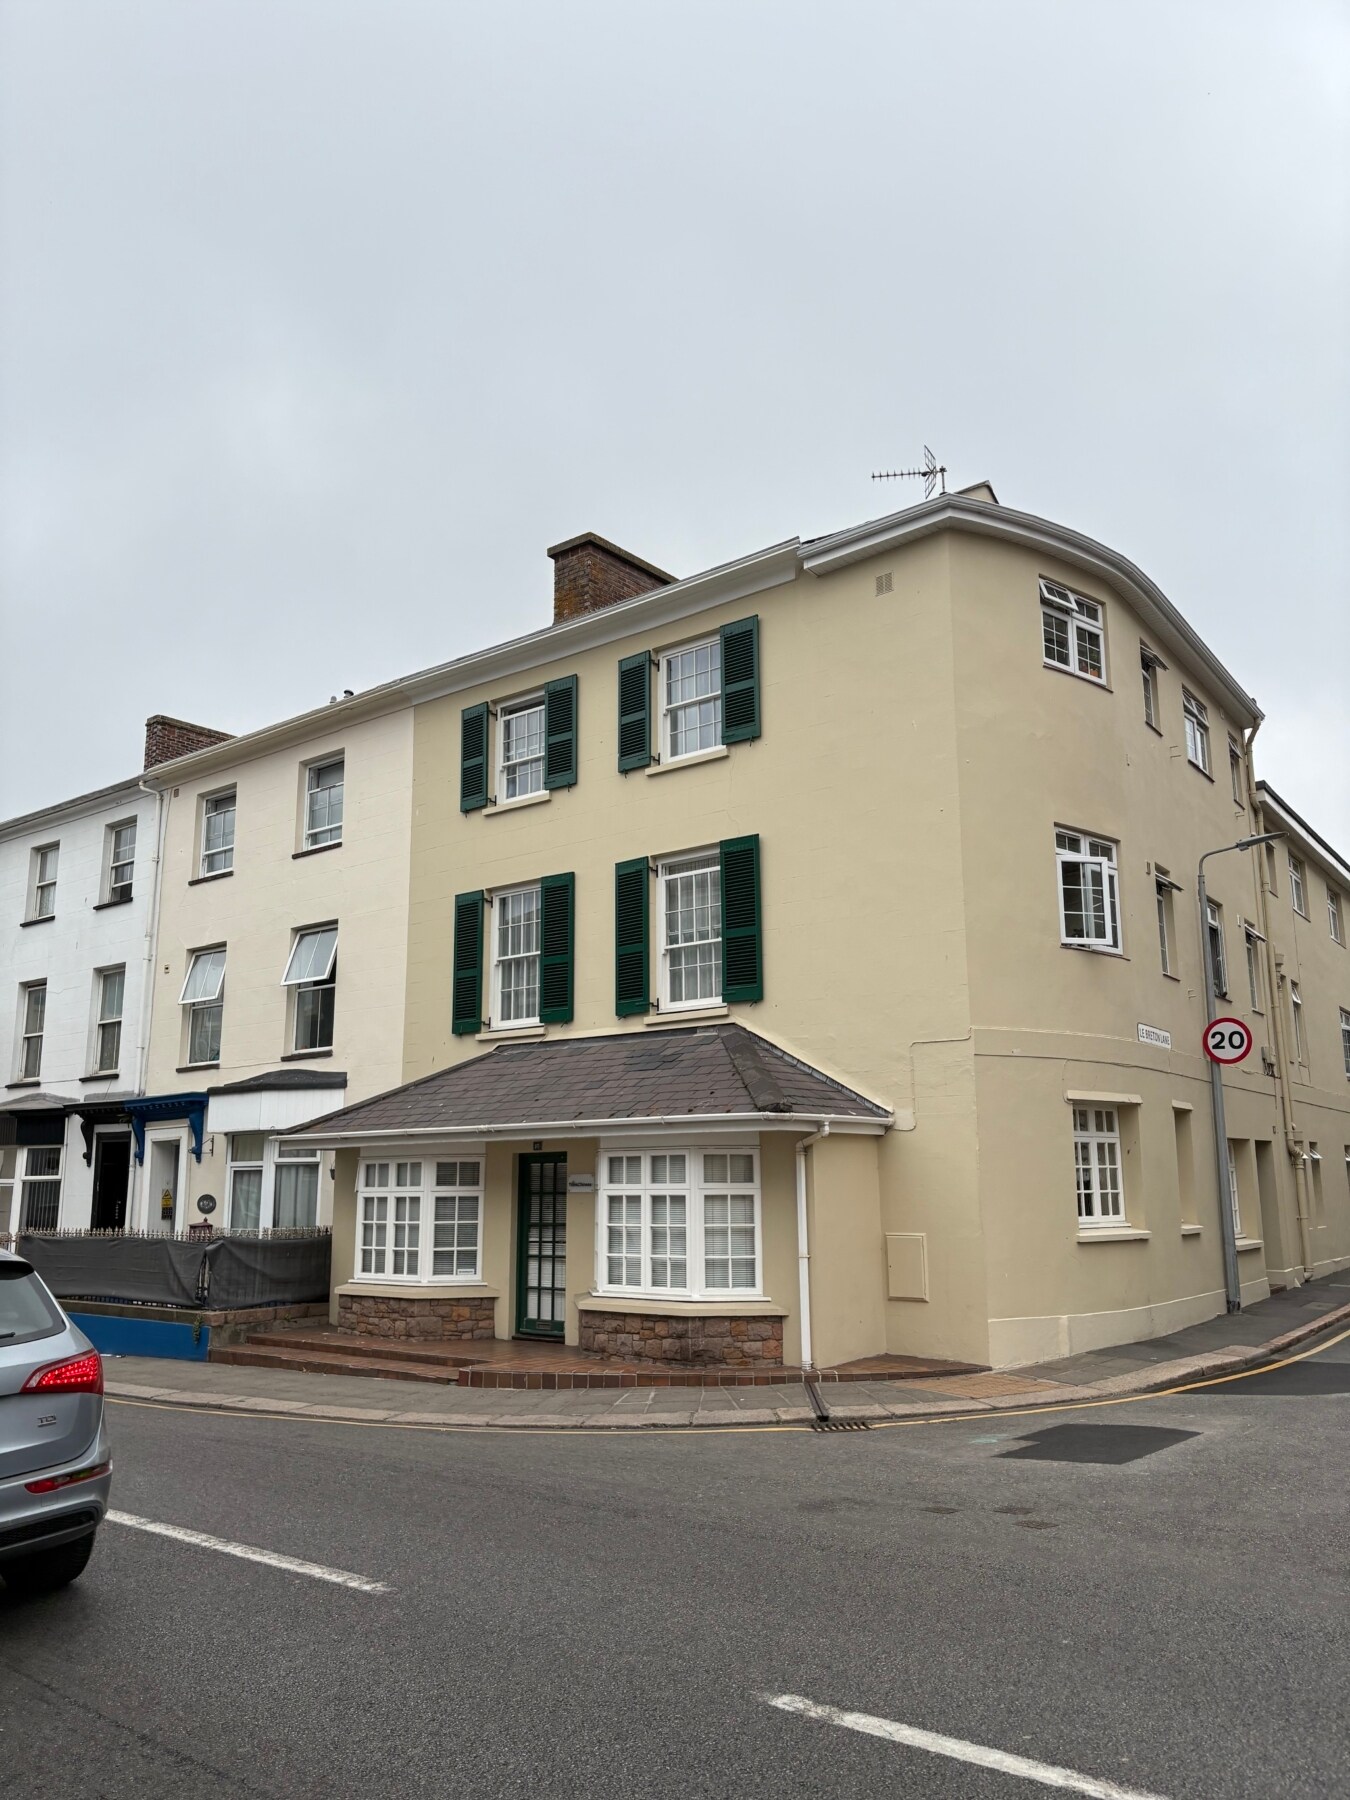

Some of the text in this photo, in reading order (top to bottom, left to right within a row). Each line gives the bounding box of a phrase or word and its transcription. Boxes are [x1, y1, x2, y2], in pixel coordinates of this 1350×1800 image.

[1140, 1028, 1170, 1045] LE BRETON LANE
[1211, 1031, 1245, 1049] 20
[37, 1415, 56, 1424] TDI
